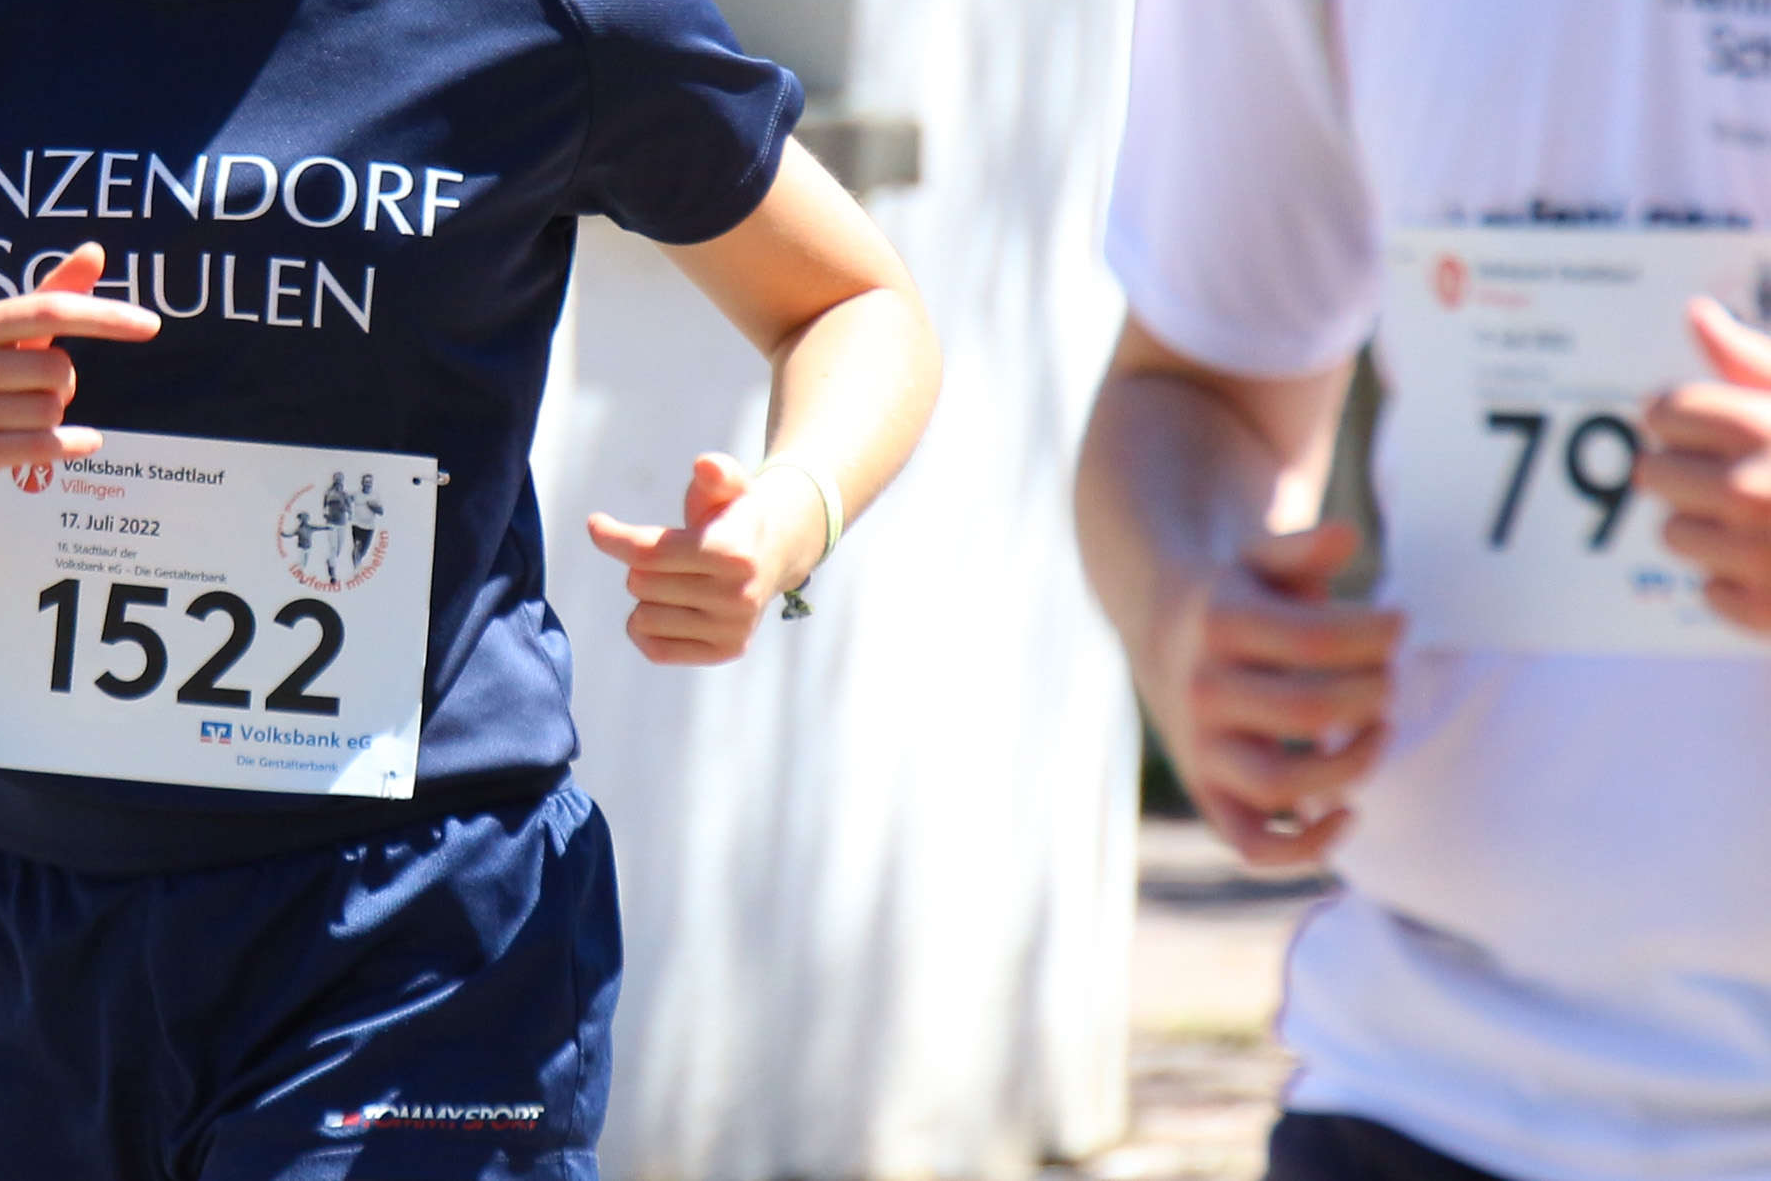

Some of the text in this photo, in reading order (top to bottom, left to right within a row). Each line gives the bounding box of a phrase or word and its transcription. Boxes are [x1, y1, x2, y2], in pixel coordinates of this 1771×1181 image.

[63, 458, 226, 485] Volksbank Stadtlauf
[61, 479, 126, 500] Villingen
[60, 512, 161, 536] 17. Juli 2022
[74, 544, 118, 557] Stadtlauf
[121, 548, 138, 559] der
[288, 530, 389, 593] laufend mithelfen
[55, 558, 105, 572] Volksbank
[108, 564, 123, 575] eG
[134, 566, 152, 577] Die
[154, 568, 228, 583] Gestalterbank
[38, 579, 345, 717] 1522
[240, 724, 372, 750] Volksbank eG
[236, 755, 339, 772] Die Gestalterbank
